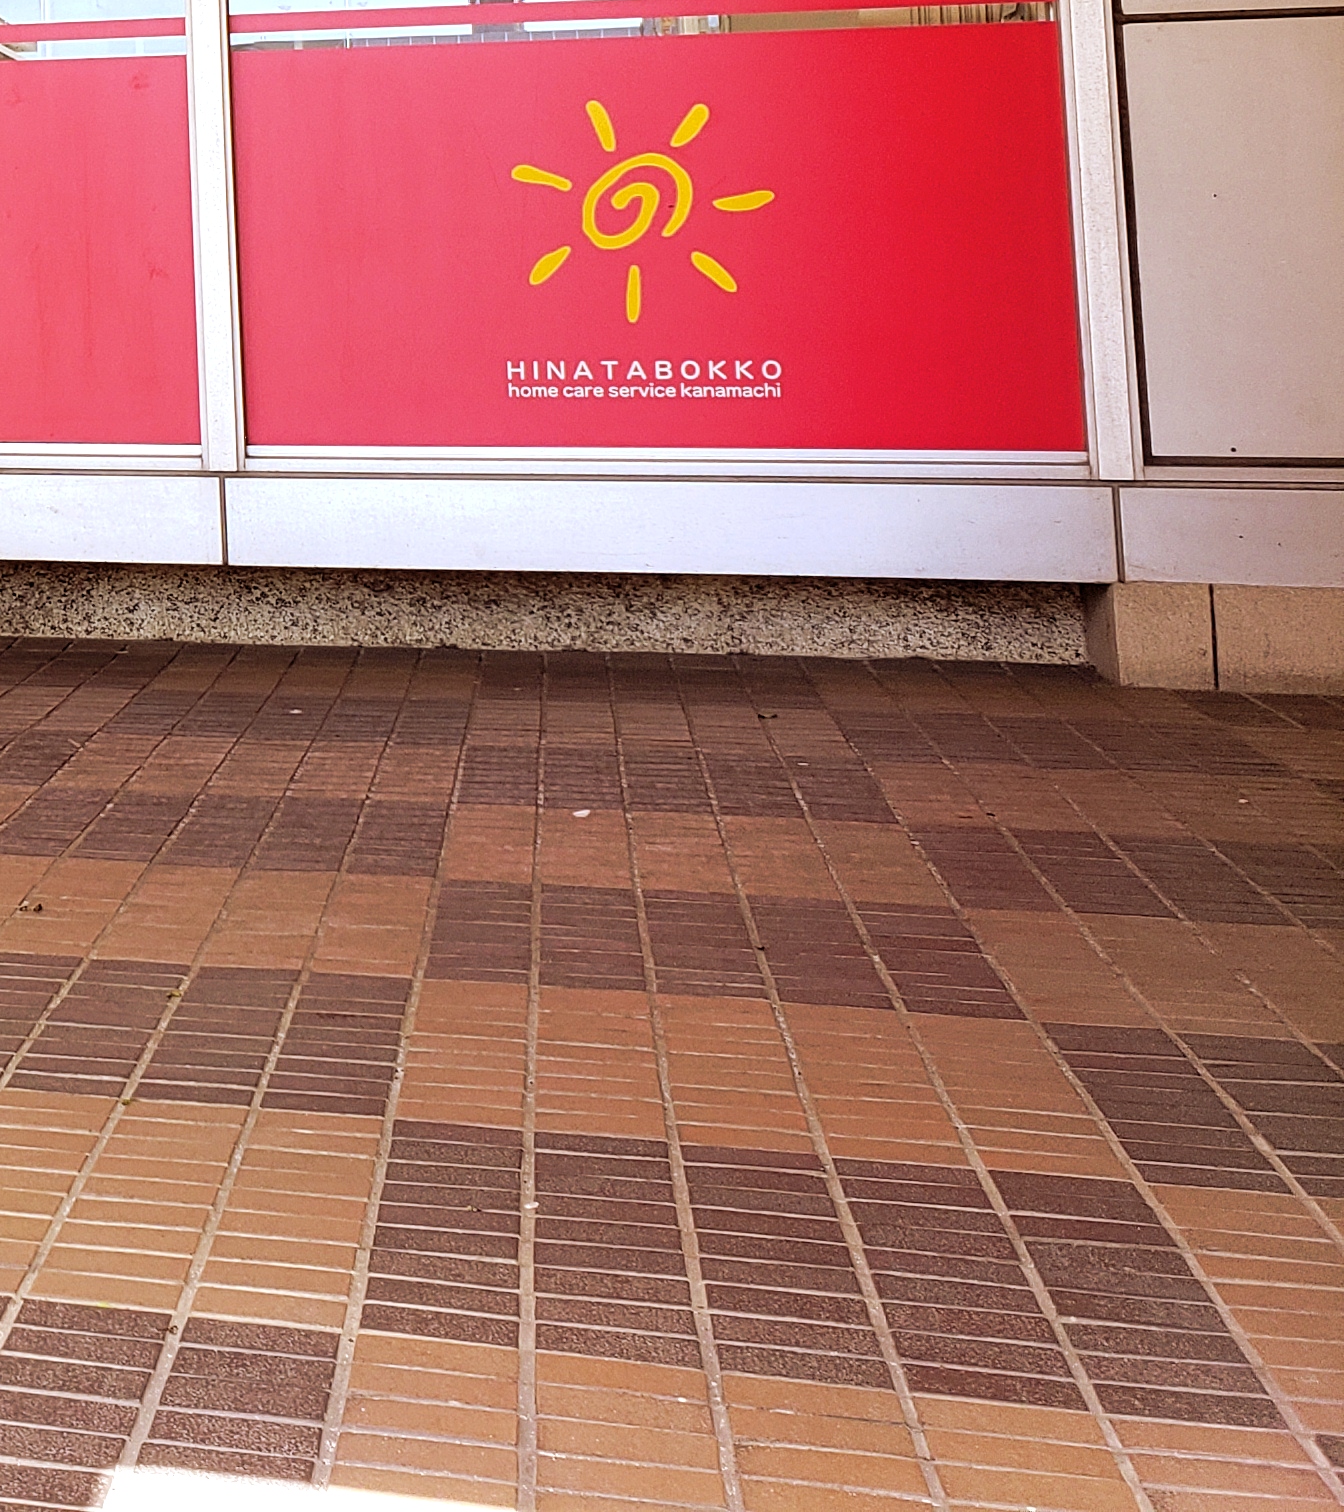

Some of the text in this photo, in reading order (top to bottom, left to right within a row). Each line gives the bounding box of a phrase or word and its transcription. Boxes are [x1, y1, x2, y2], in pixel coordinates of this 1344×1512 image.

[506, 360, 782, 380] HINATABOKKO
[508, 383, 781, 398] home care service kanamachi
